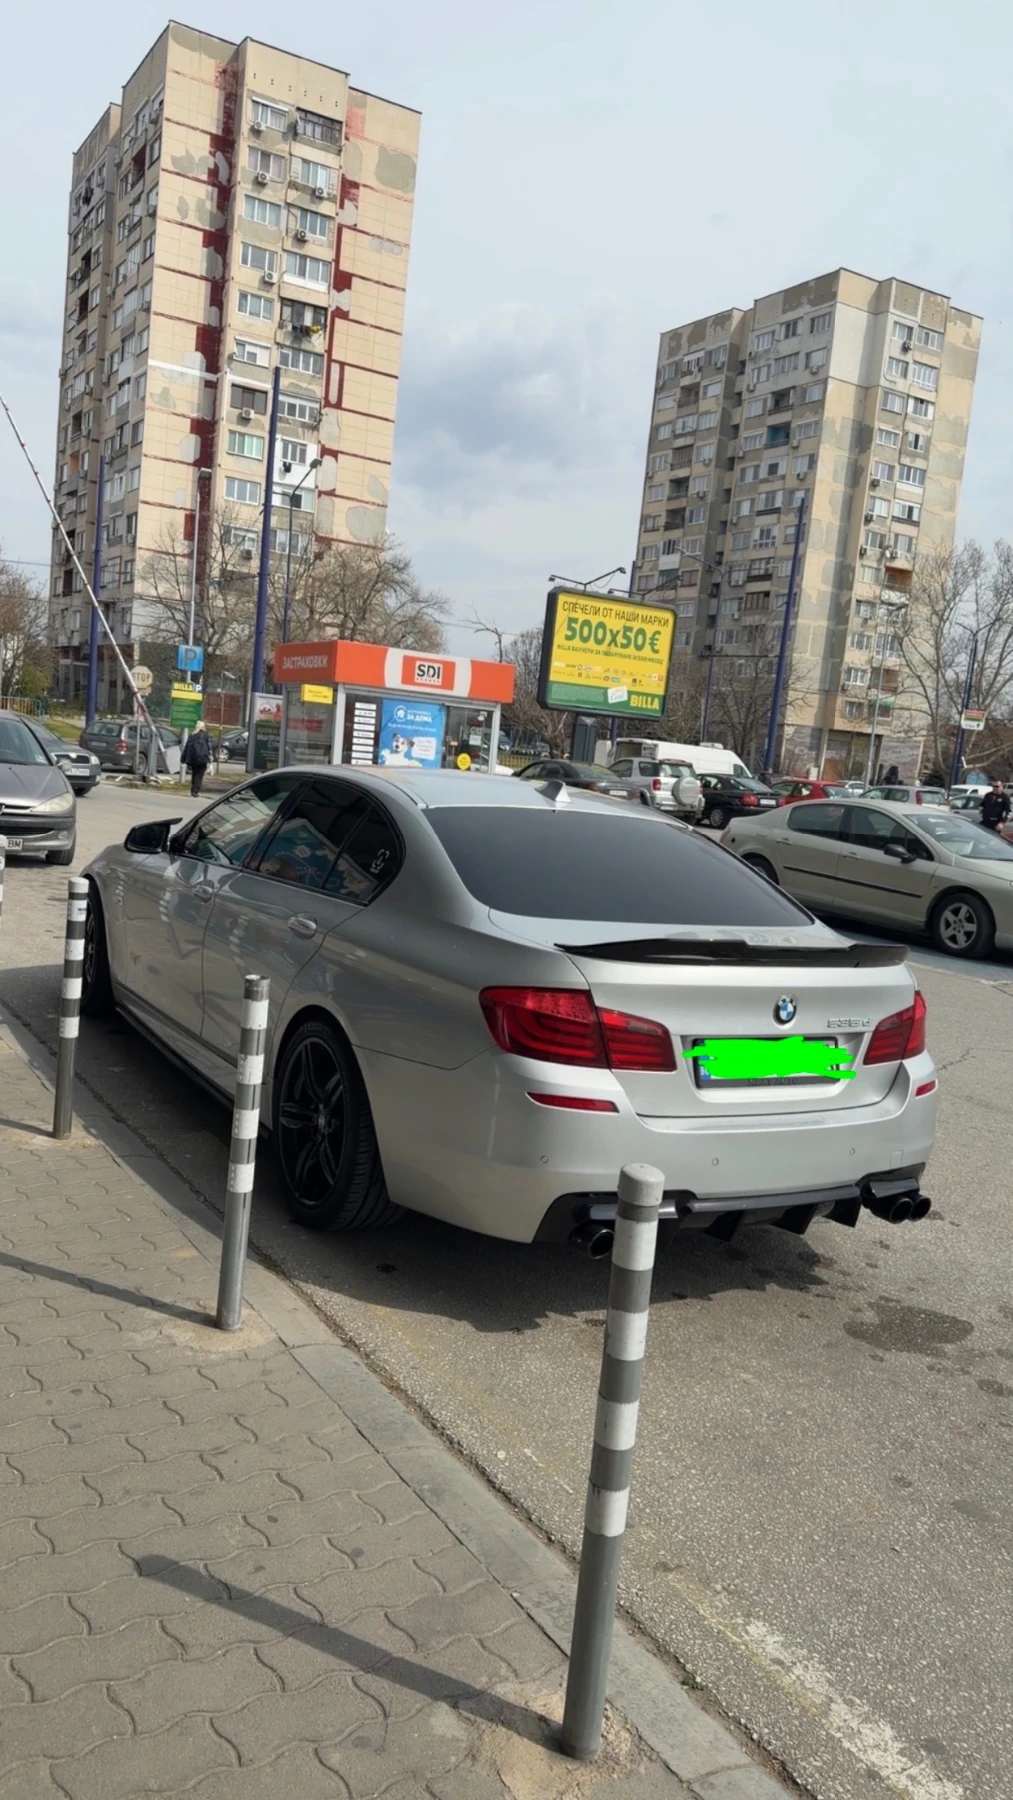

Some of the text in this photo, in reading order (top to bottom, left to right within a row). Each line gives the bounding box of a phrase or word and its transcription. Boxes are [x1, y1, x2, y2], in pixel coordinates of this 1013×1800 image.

[562, 600, 669, 628] СПЕЧЕЛИ ОТ НАШИ МАРКИ
[184, 648, 197, 668] P
[282, 655, 328, 670] ЗАСТРАХОВКИ
[133, 673, 151, 681] STOP
[417, 664, 441, 680] SDI
[173, 682, 202, 693] BILLA P
[630, 694, 659, 710] BILLA
